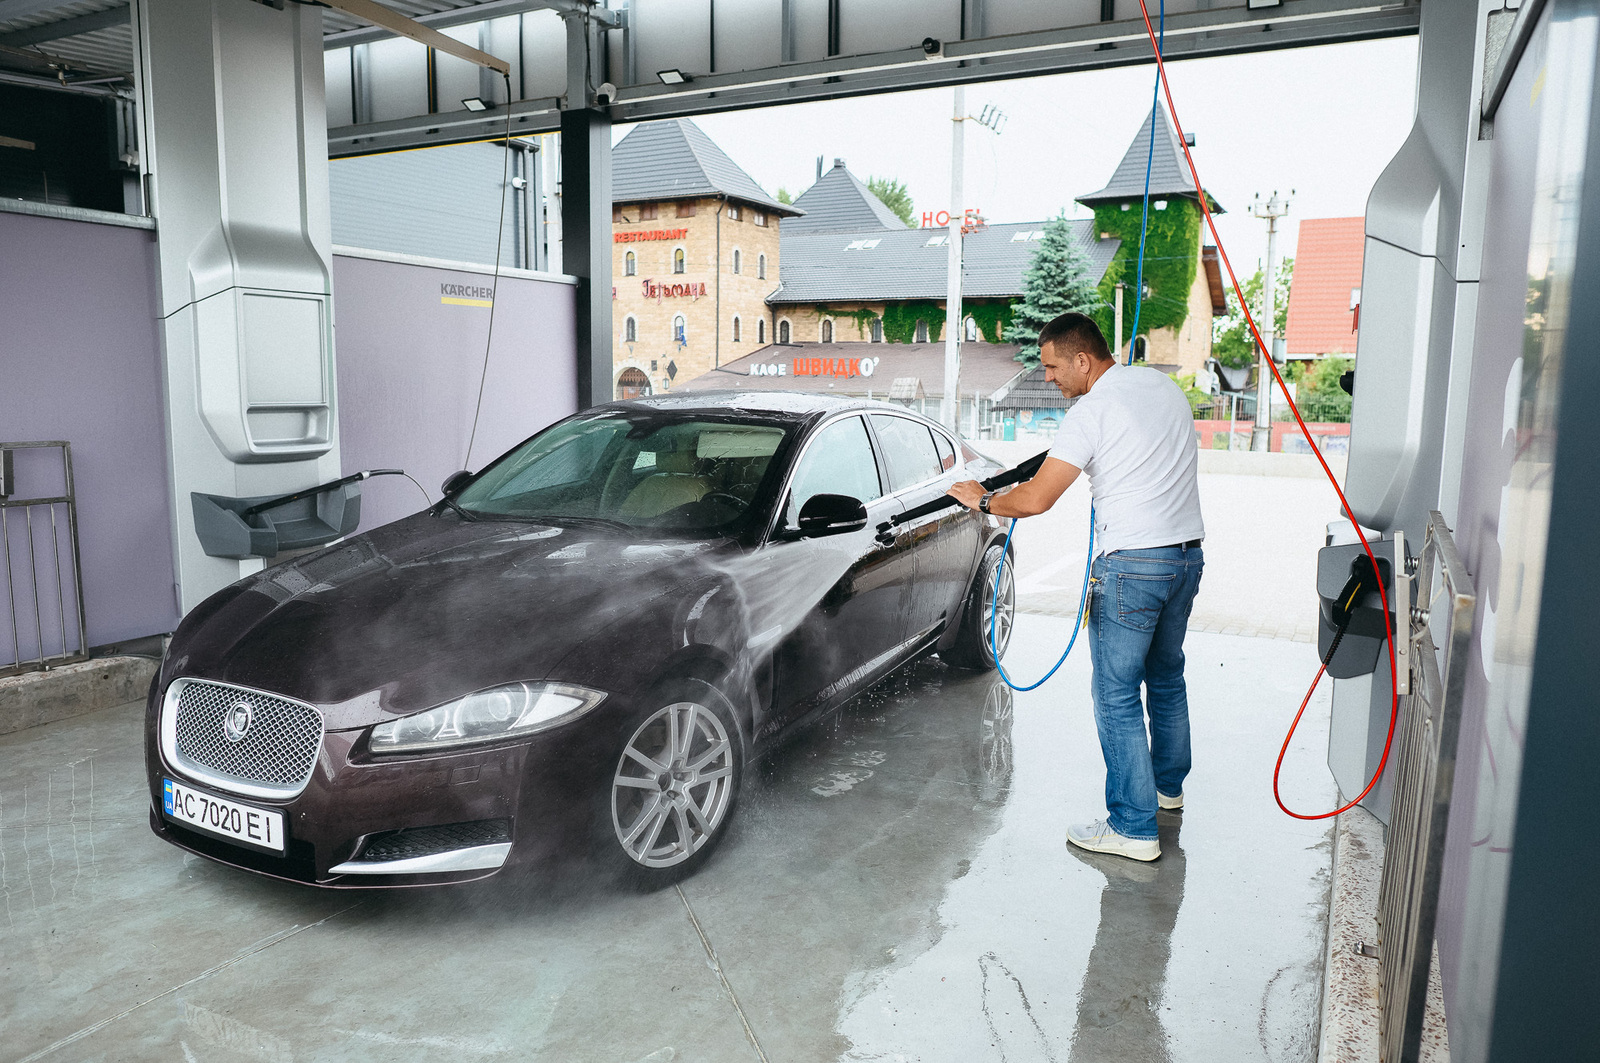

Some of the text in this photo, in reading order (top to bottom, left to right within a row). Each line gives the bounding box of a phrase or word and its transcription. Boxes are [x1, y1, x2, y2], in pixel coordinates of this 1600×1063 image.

[922, 208, 984, 227] HOEL
[614, 228, 688, 243] RESTAURANT
[441, 283, 493, 299] KÄRCHER
[750, 363, 786, 376] КАФЕ
[165, 800, 172, 810] UA
[200, 798, 241, 833] 7020
